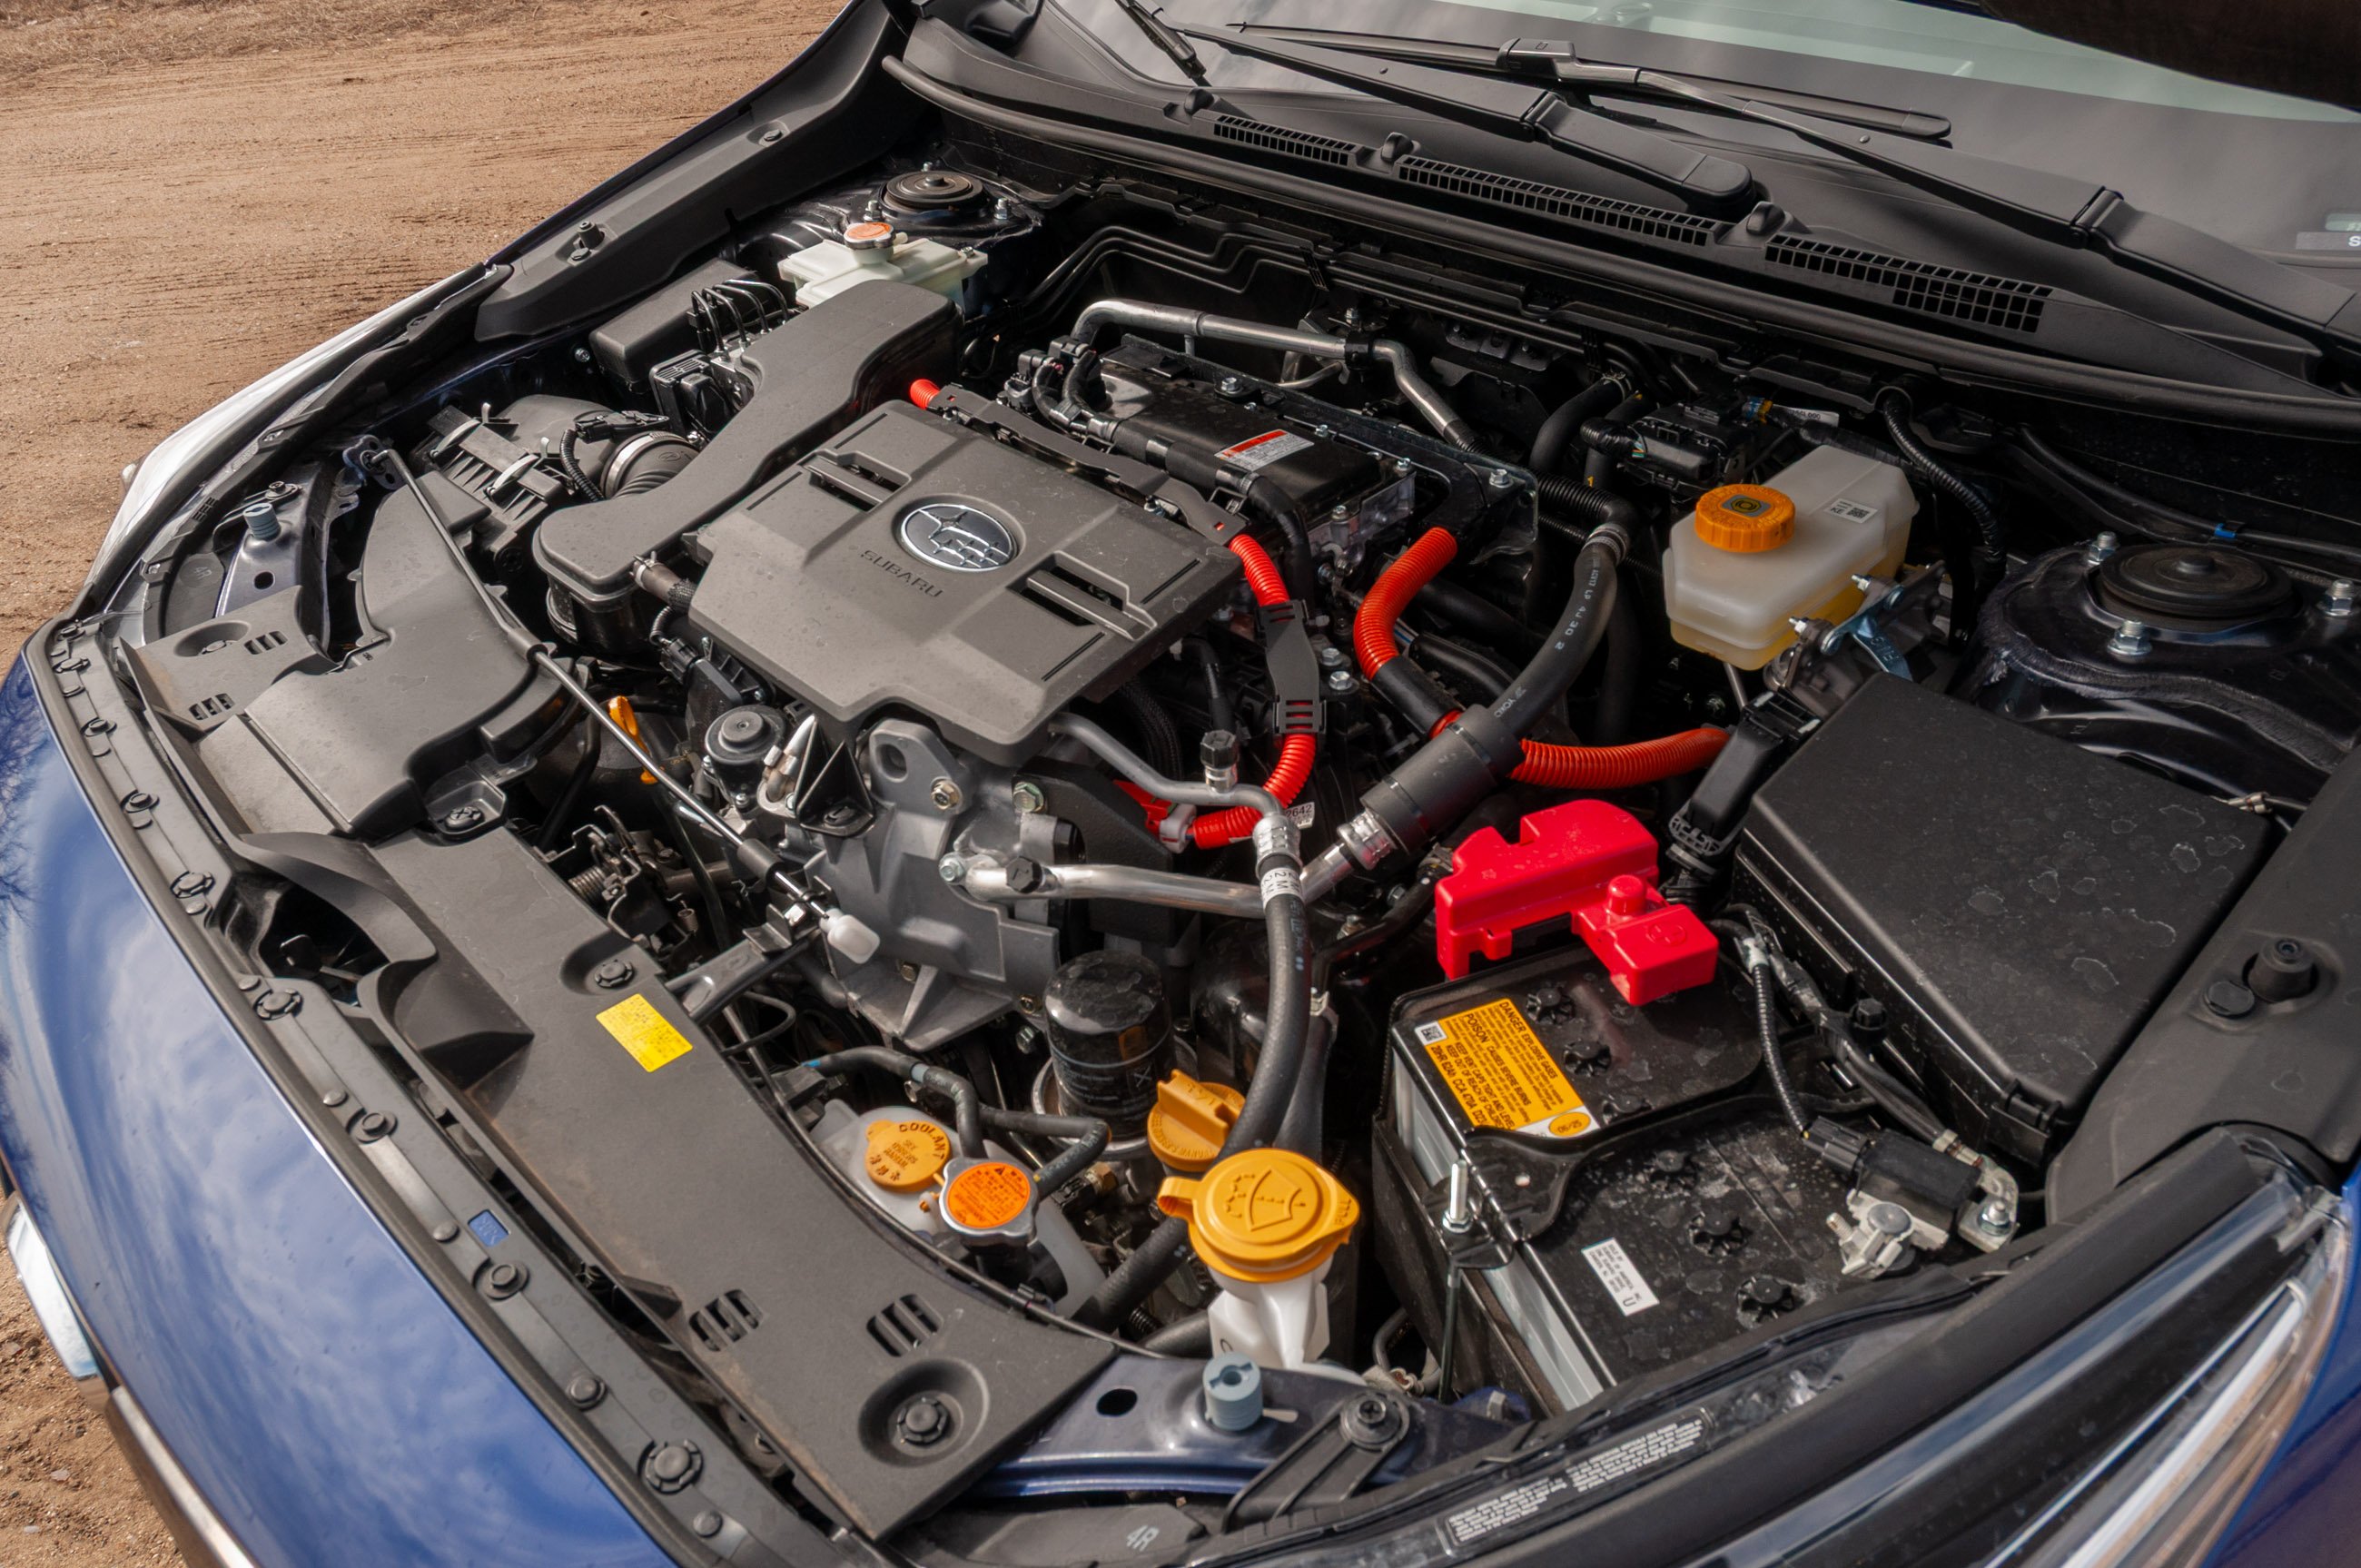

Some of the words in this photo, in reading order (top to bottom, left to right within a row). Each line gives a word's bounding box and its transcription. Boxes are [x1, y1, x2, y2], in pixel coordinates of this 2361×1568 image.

[193, 566, 212, 580] 4R
[860, 549, 944, 597] SUBARU
[1275, 871, 1288, 888] 2M
[1498, 1002, 1526, 1033] DANGER
[1521, 1034, 1546, 1062] EXPLOSIVE
[1540, 1060, 1557, 1079] GASES
[1464, 1014, 1489, 1043] POISON
[1487, 1047, 1504, 1066] CAUSES
[1500, 1067, 1517, 1087] SEVERE
[1514, 1088, 1530, 1106] BURNS
[899, 1121, 945, 1160] COOLANT
[1623, 1297, 1635, 1307] U
[1126, 1525, 1160, 1552] 4R
